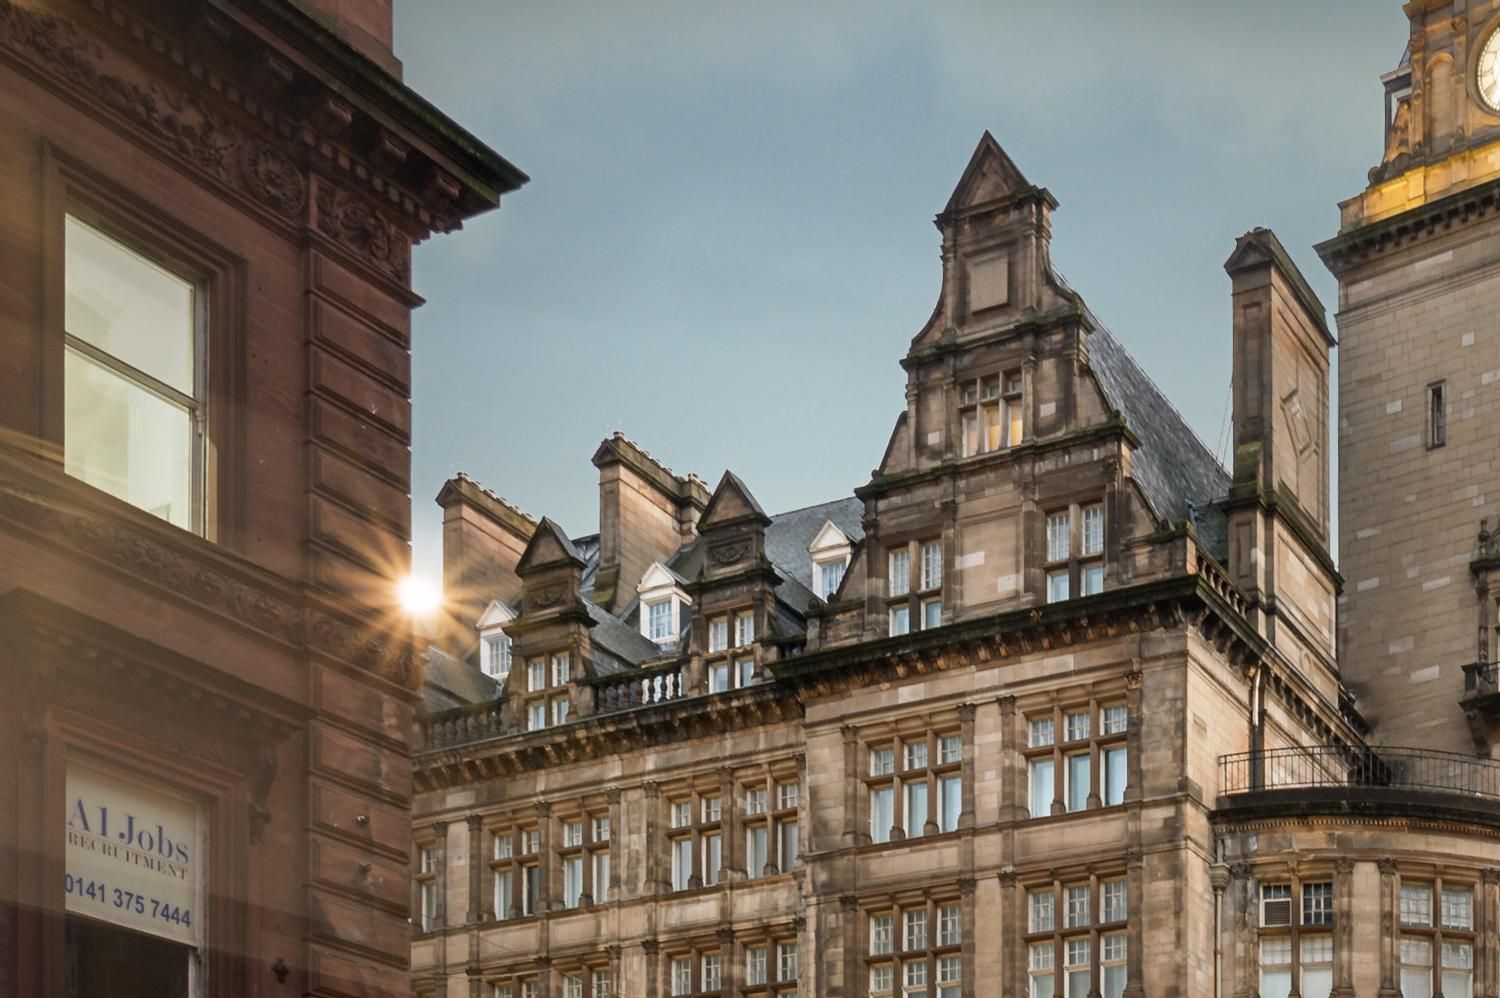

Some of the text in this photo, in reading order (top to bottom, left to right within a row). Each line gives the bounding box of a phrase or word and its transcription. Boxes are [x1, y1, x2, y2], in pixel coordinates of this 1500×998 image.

[68, 831, 188, 881] RECRUITMENT
[119, 813, 189, 864] Jobs
[64, 874, 191, 928] 0141 375 7444
